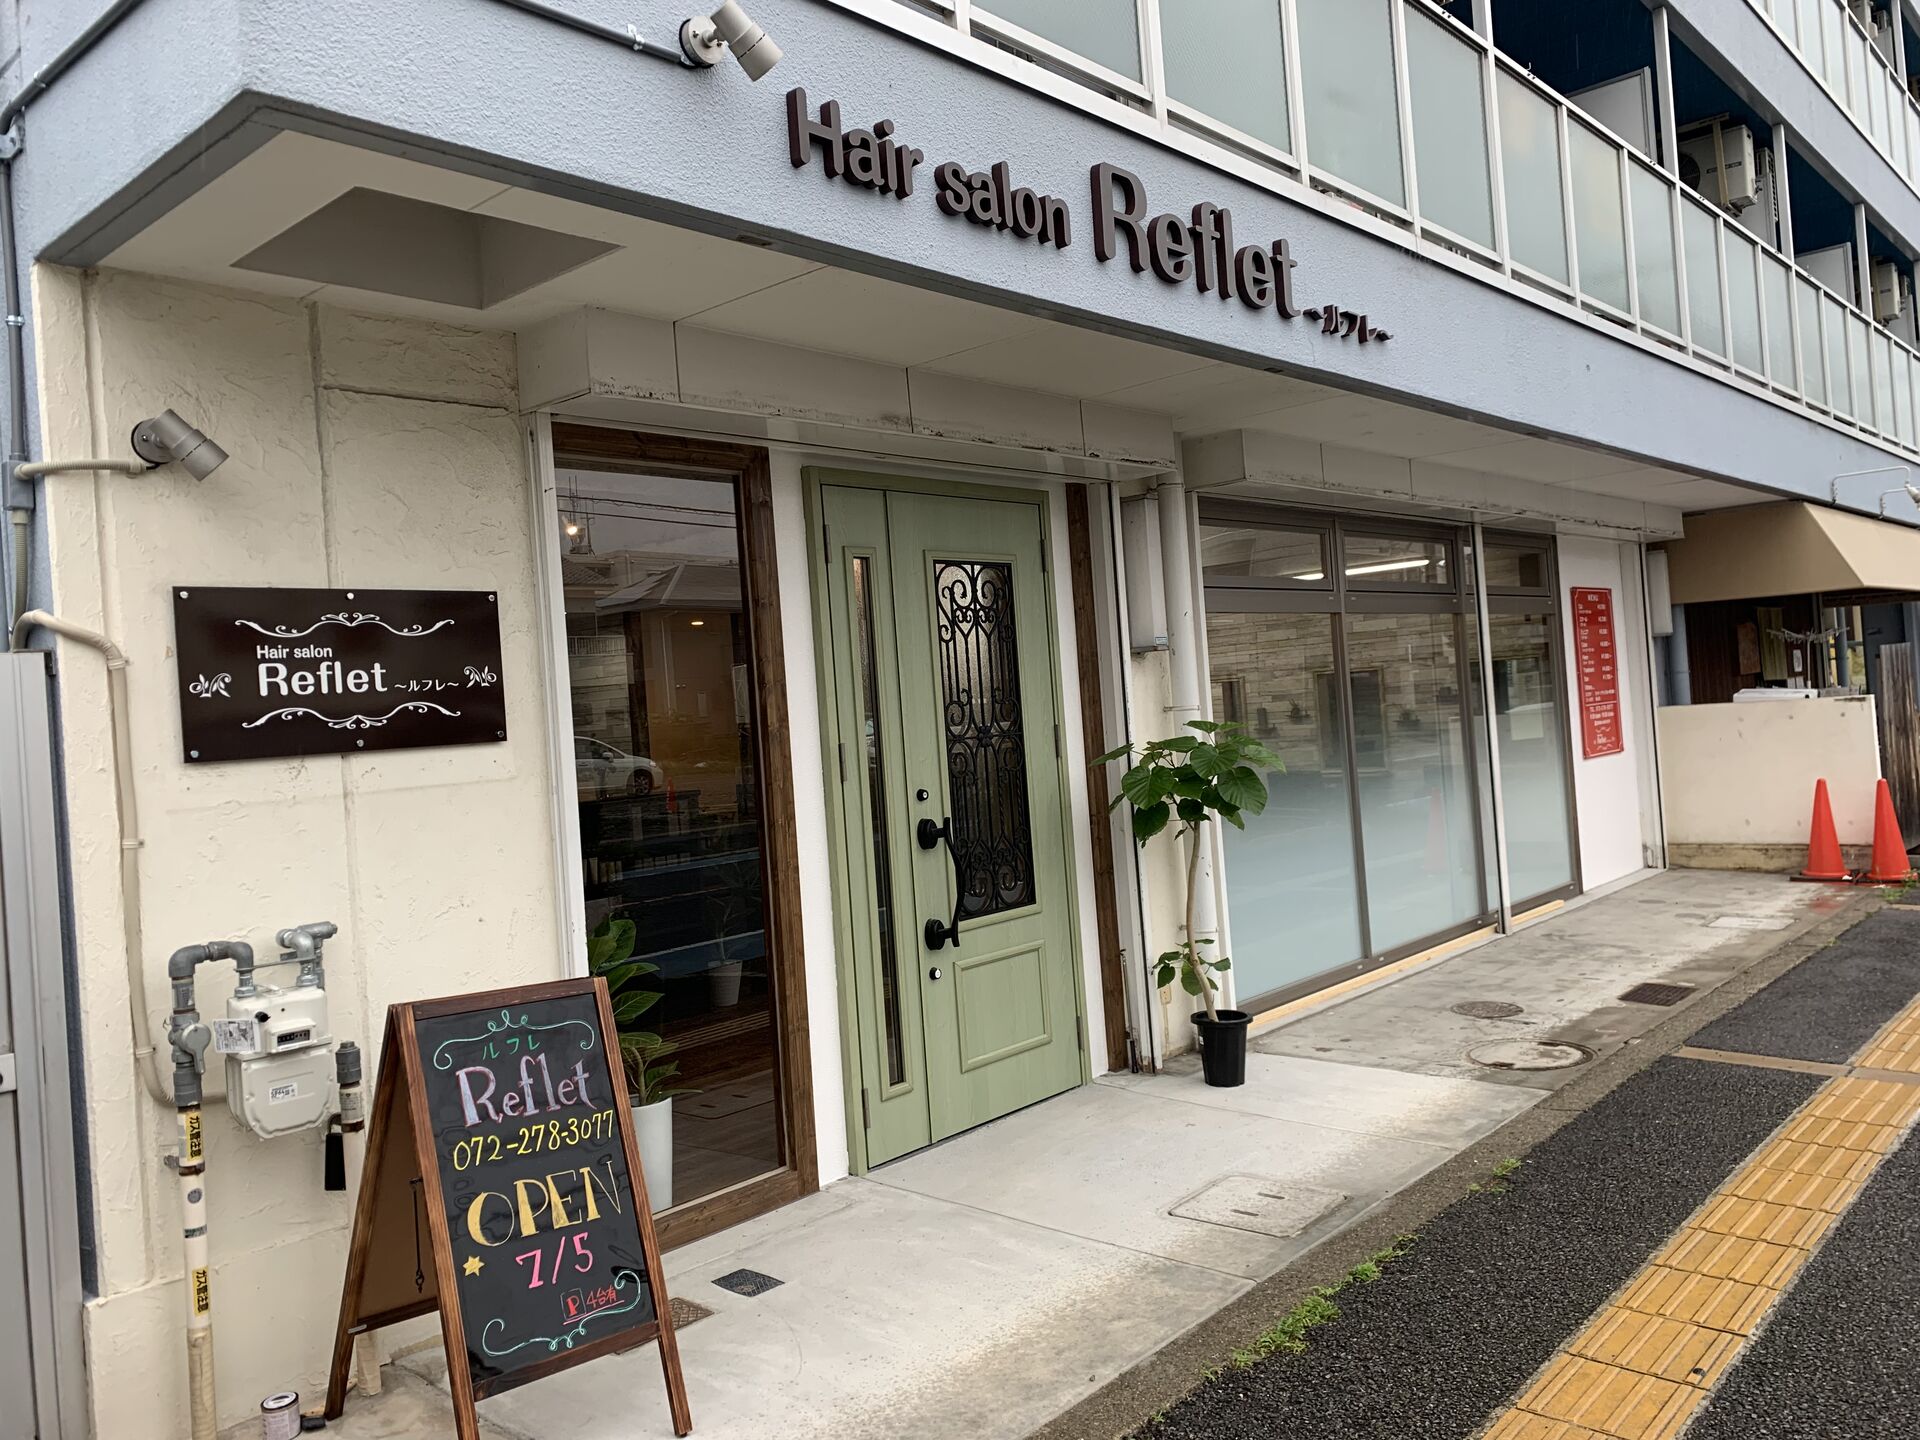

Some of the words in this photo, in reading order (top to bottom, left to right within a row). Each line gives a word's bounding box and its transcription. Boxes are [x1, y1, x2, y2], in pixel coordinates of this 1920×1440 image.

[786, 86, 923, 200] Hair
[934, 160, 1071, 248] salon
[1090, 162, 1301, 319] Reflet
[256, 645, 289, 659] Hair
[294, 645, 333, 658] salon
[257, 660, 388, 697] Reflet
[482, 1034, 541, 1061] ルフレ
[455, 1051, 598, 1128] Reflet
[453, 1109, 614, 1170] 072-278-3077
[466, 1160, 622, 1247] OPEN
[516, 1232, 594, 1289] 7/5
